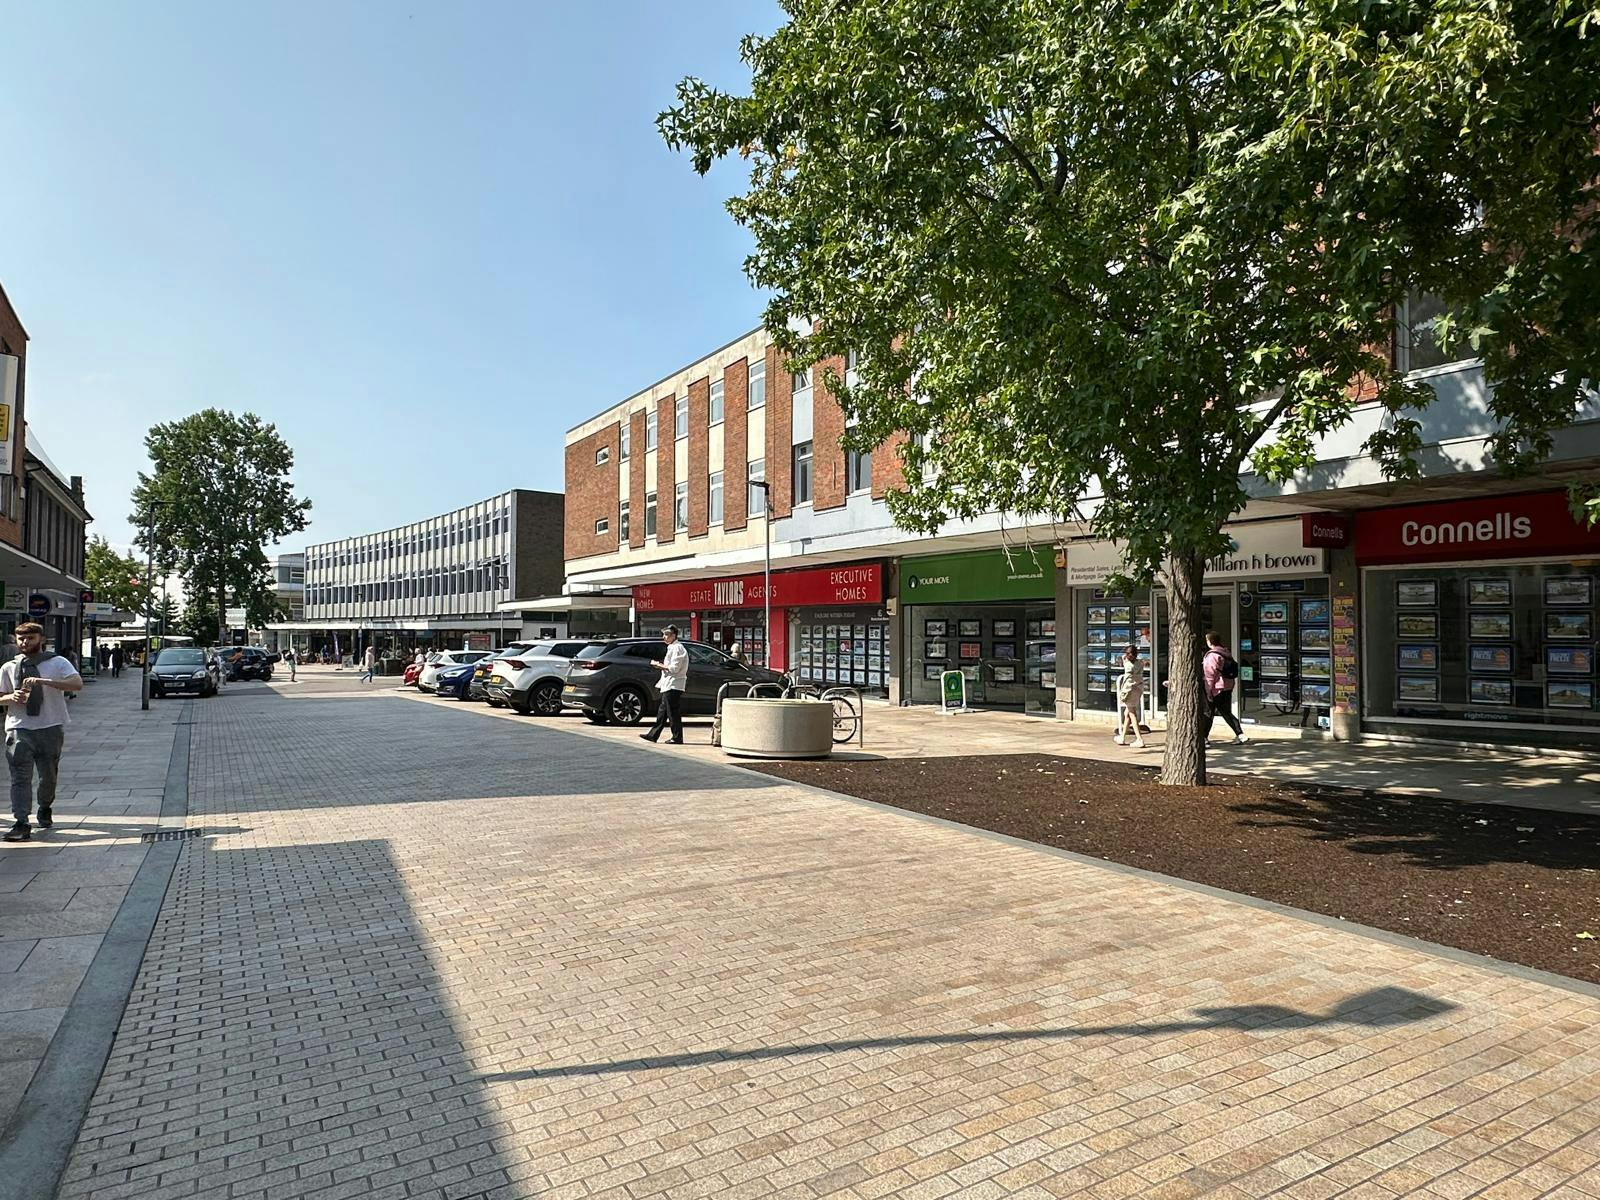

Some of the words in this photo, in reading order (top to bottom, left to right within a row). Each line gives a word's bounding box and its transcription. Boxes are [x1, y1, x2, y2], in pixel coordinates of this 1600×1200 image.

[1312, 524, 1343, 539] Connells
[1402, 512, 1532, 546] Connells
[1252, 555, 1261, 569] h
[1264, 553, 1316, 569] brown
[830, 568, 873, 585] EXECUTIVE
[919, 577, 934, 585] YOUR
[934, 576, 950, 584] MOVE
[639, 589, 651, 598] NEW
[690, 590, 711, 603] ESTATE
[713, 580, 744, 606] TAYLORS
[748, 585, 777, 599] AGENTS
[835, 586, 867, 601] HOMES
[636, 599, 654, 609] HOMES
[1464, 711, 1509, 721] rightmove
